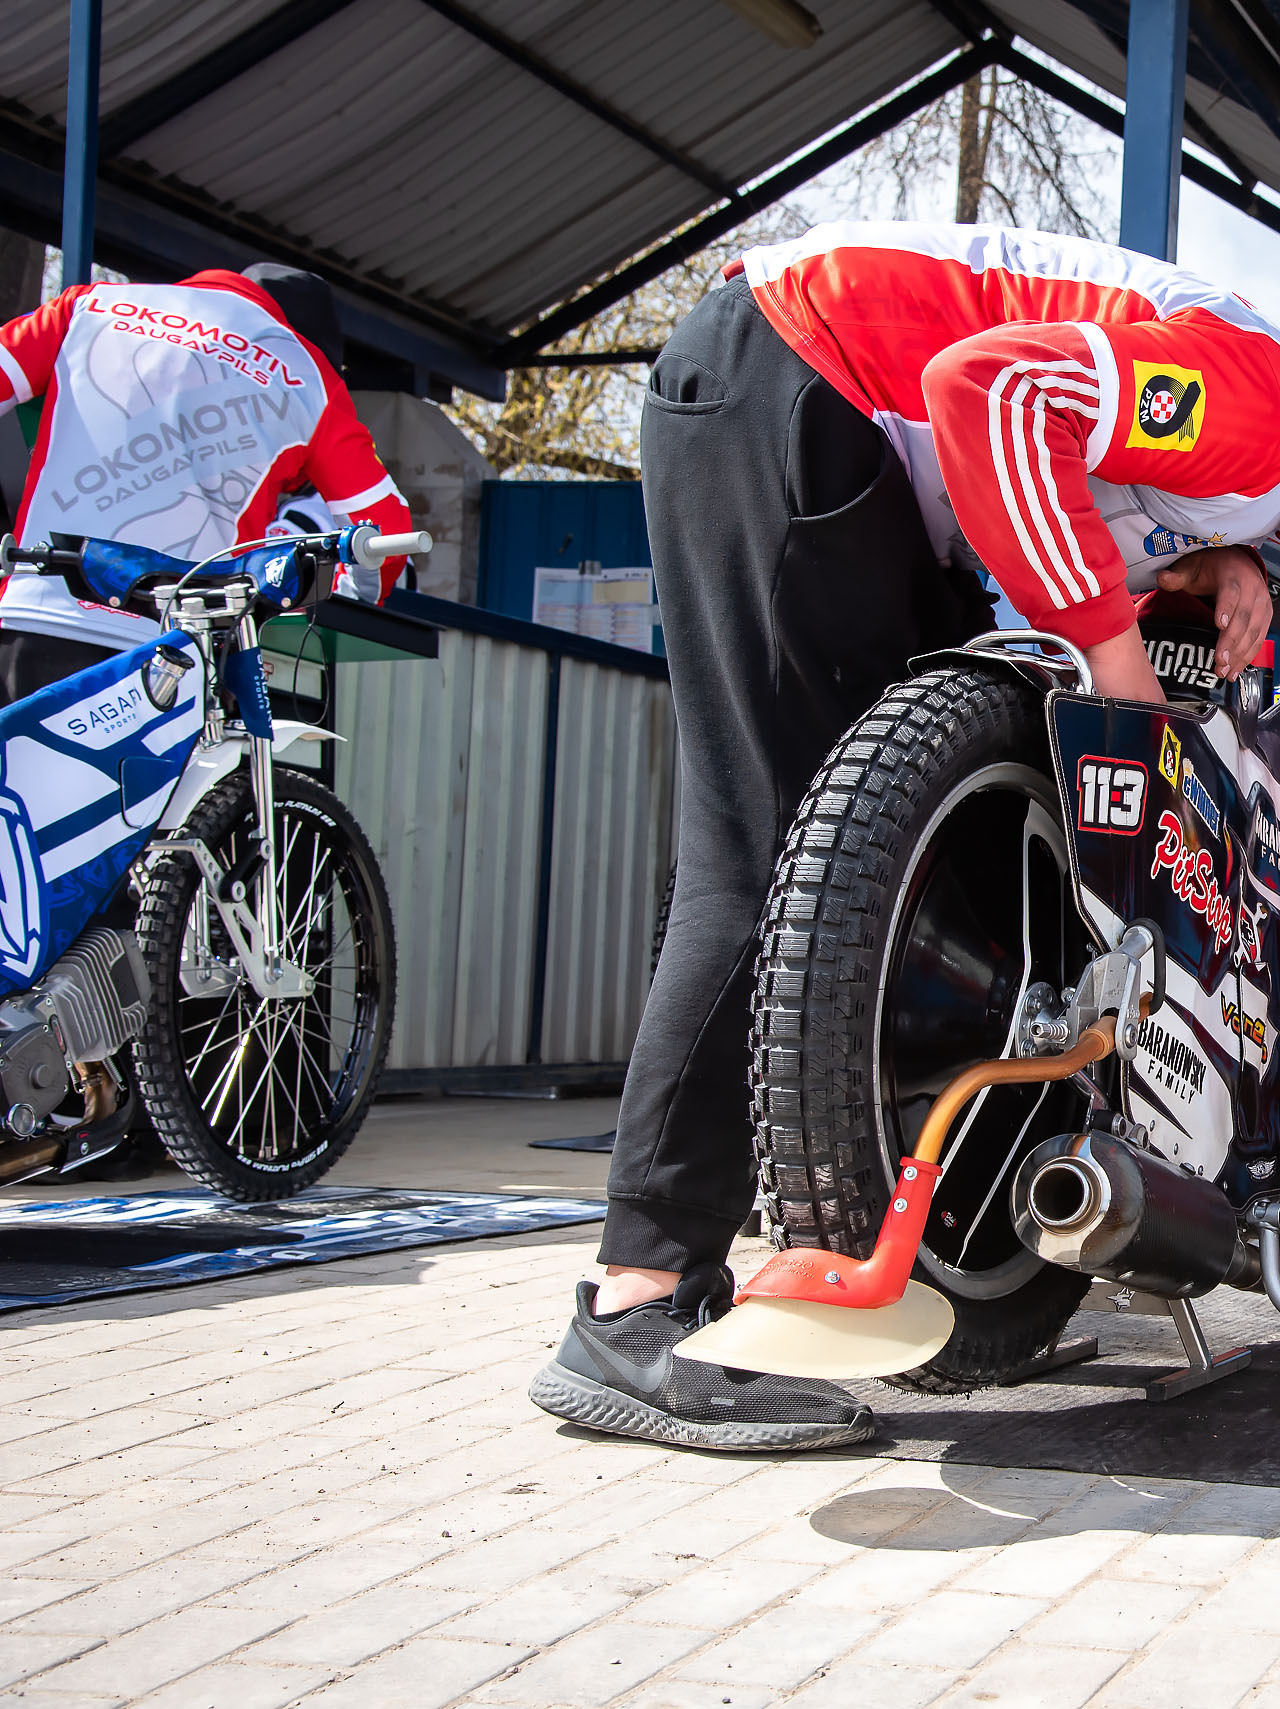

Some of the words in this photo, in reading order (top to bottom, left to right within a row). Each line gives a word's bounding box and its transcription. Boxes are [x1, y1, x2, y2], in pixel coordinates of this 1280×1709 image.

[88, 298, 303, 386] LOKOMOTIV
[113, 320, 270, 386] DAUGAVPILS
[1139, 388, 1154, 424] PZM
[51, 391, 290, 513] LOKOMOTIV
[95, 433, 258, 512] DAUGAVPILS
[1177, 666, 1220, 690] 113
[103, 713, 137, 734] SPORTS
[1082, 764, 1145, 827] 113
[1151, 810, 1233, 955] PitStop
[1147, 1058, 1196, 1105] FAMILY
